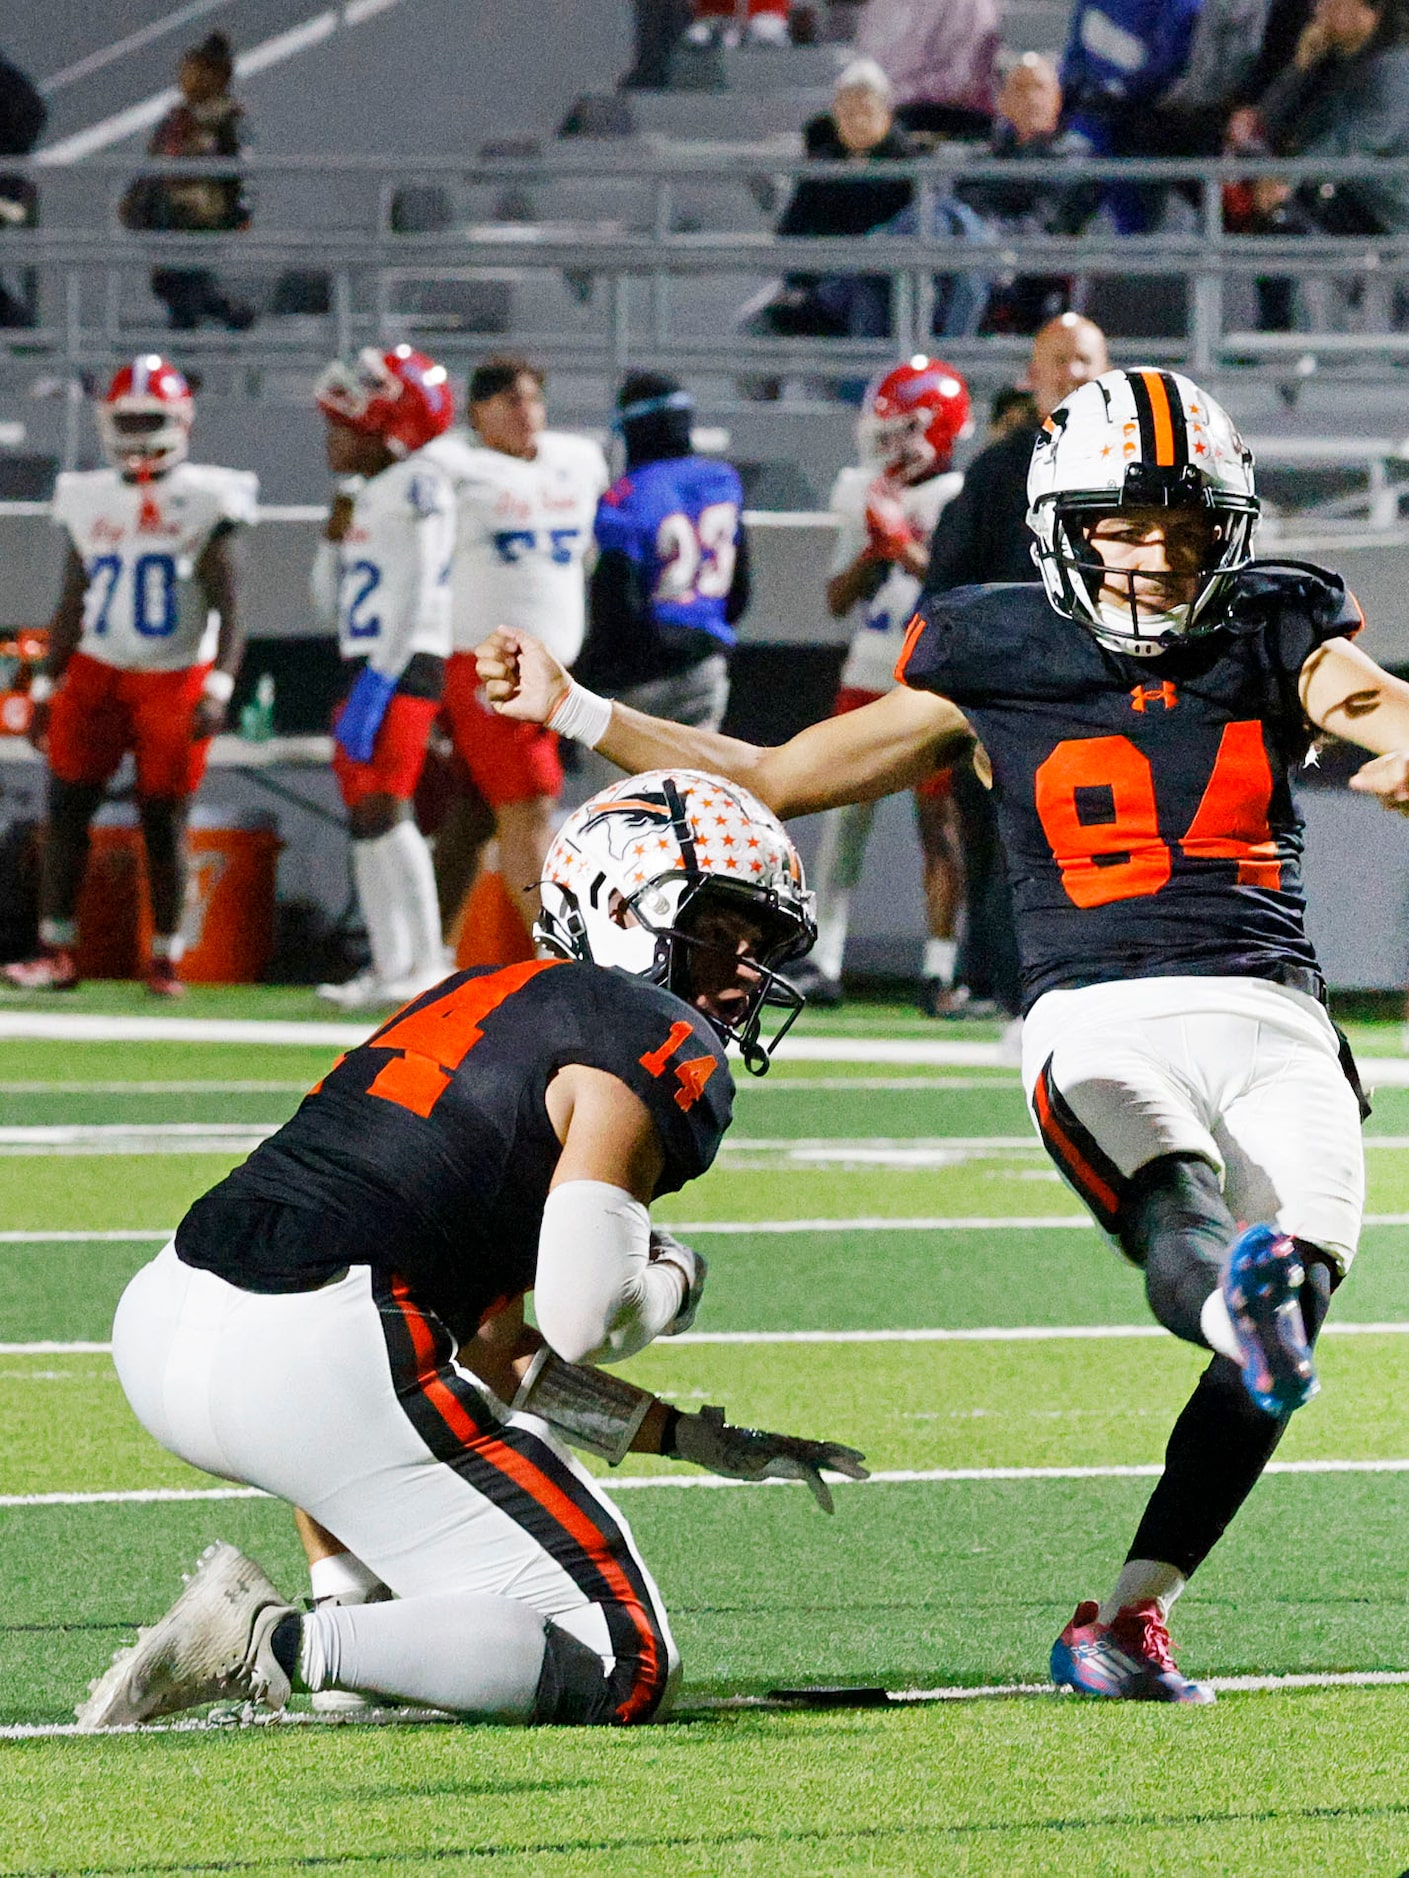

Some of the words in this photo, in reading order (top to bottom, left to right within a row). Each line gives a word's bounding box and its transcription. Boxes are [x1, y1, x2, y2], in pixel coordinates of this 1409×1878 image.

[88, 554, 179, 638] 70
[655, 502, 738, 605] 23
[1034, 719, 1283, 909] 84
[638, 1020, 718, 1113] 14
